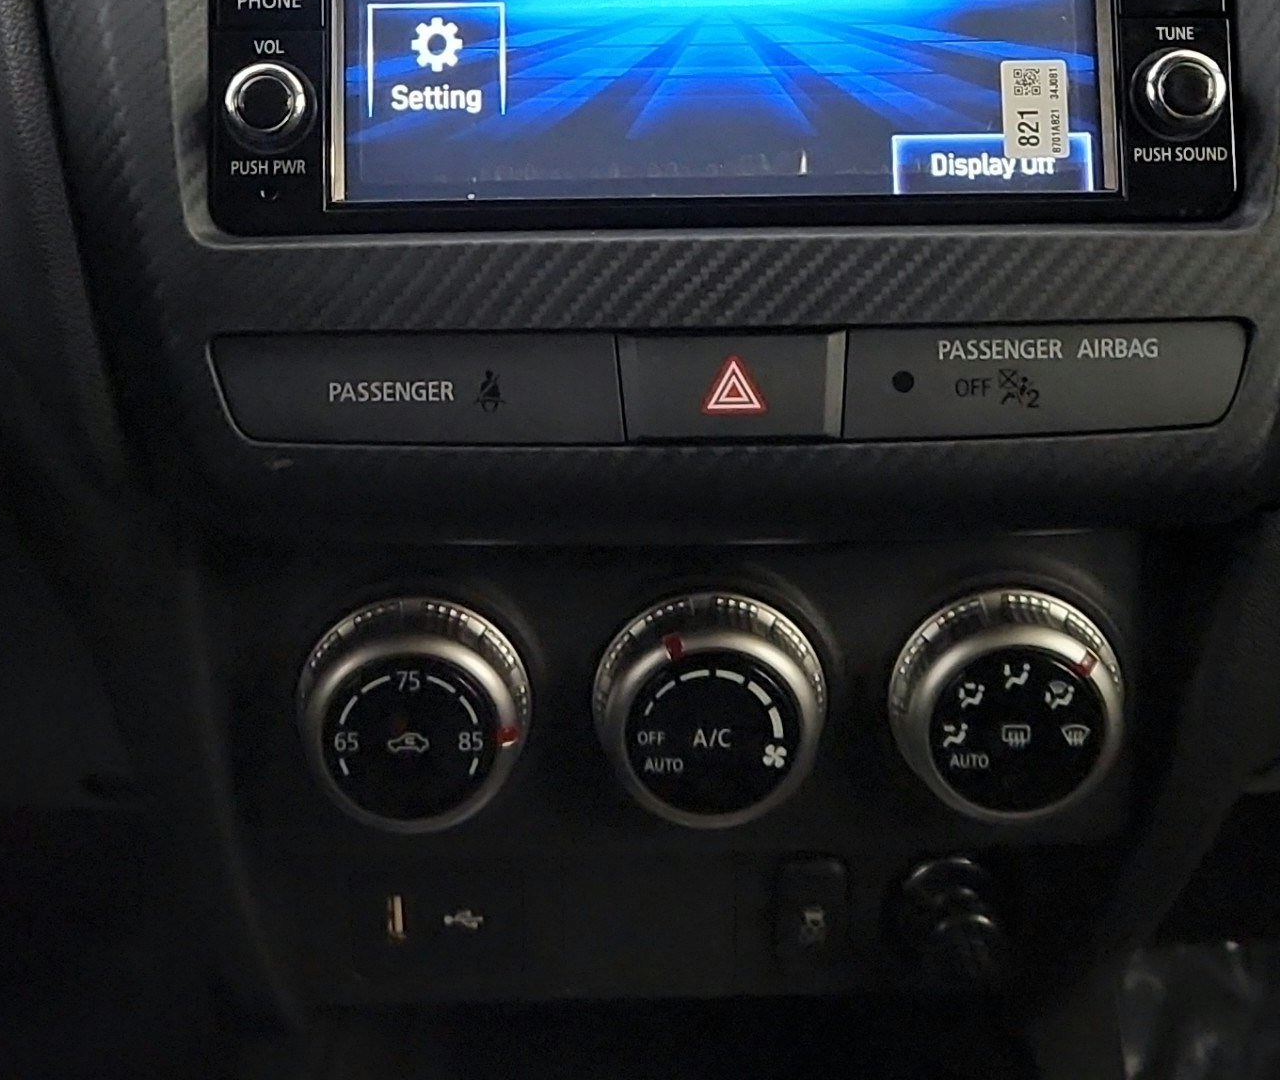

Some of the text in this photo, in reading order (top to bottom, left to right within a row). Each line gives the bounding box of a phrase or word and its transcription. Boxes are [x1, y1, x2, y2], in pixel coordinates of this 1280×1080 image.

[1155, 26, 1195, 41] TUNE
[253, 39, 285, 54] VOL
[391, 84, 482, 114] Setting
[1016, 110, 1041, 147] 821
[1049, 109, 1062, 153] 8701A821
[1133, 146, 1228, 163] PUSH SOUND
[230, 159, 306, 176] PUSH PWR
[930, 152, 1016, 180] Display
[937, 337, 1160, 361] PASSENGER AIRBAG
[327, 381, 455, 402] PASSENGER
[954, 376, 993, 398] OFF
[395, 671, 421, 692] 75
[333, 731, 484, 752] 65 85
[637, 730, 666, 747] OFF
[692, 727, 732, 749] A/C
[644, 757, 684, 773] AUTO
[949, 753, 990, 769] AUTO
